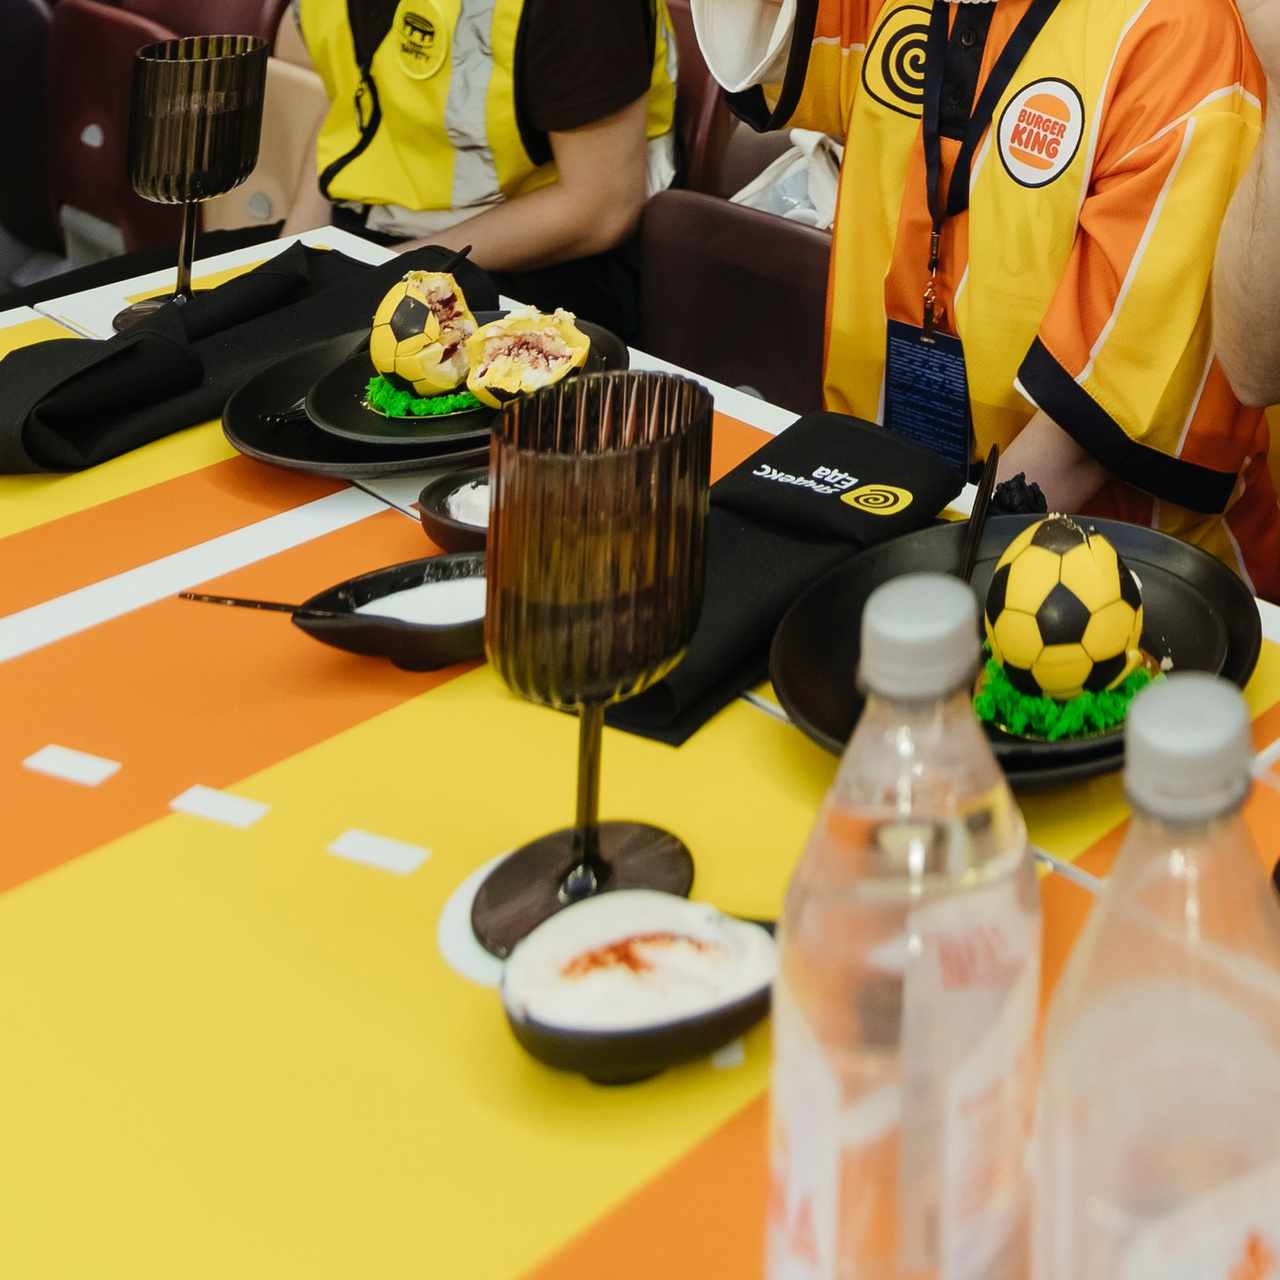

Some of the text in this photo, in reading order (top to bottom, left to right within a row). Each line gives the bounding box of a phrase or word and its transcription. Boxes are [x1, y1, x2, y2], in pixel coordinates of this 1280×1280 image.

[1017, 108, 1067, 139] BURGER
[1010, 123, 1061, 159] KING
[752, 463, 841, 495] Яндекс
[811, 455, 859, 490] Еда
